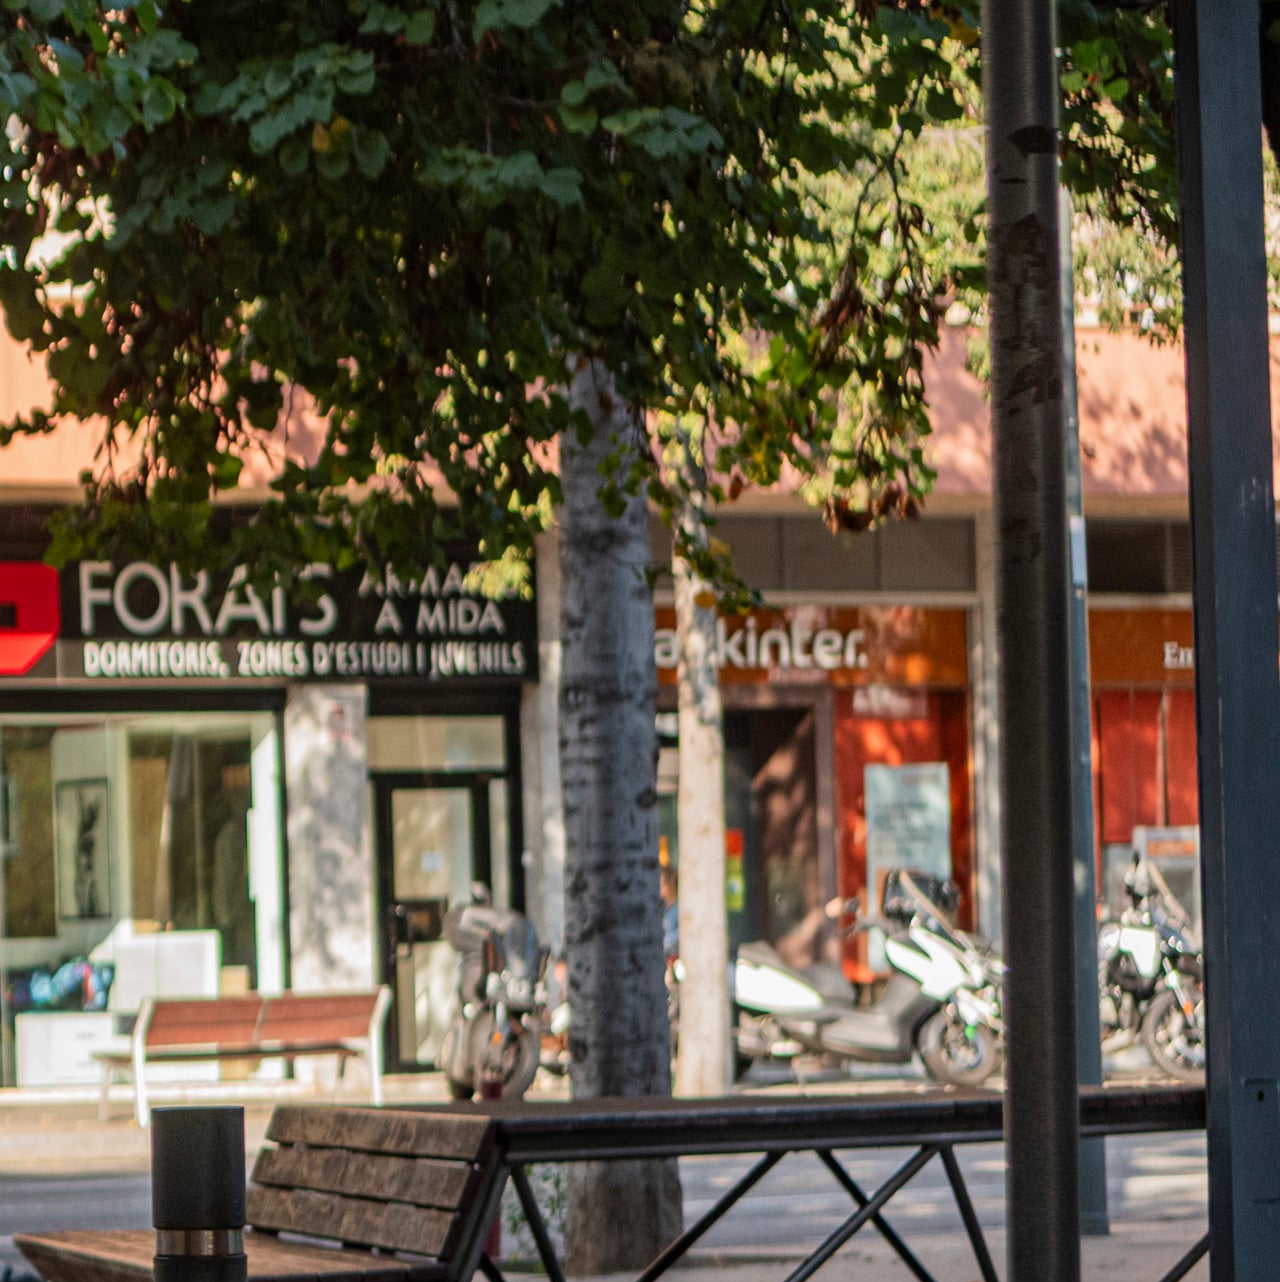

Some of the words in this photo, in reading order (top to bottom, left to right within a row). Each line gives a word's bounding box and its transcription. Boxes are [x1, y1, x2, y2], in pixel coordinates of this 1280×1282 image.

[374, 599, 403, 635] A
[416, 599, 506, 635] MIDA
[83, 641, 229, 678] DORMITORIS,
[237, 641, 309, 676] ZONES
[313, 641, 411, 676] D'ESTUDI
[430, 641, 526, 681] JUVENILS
